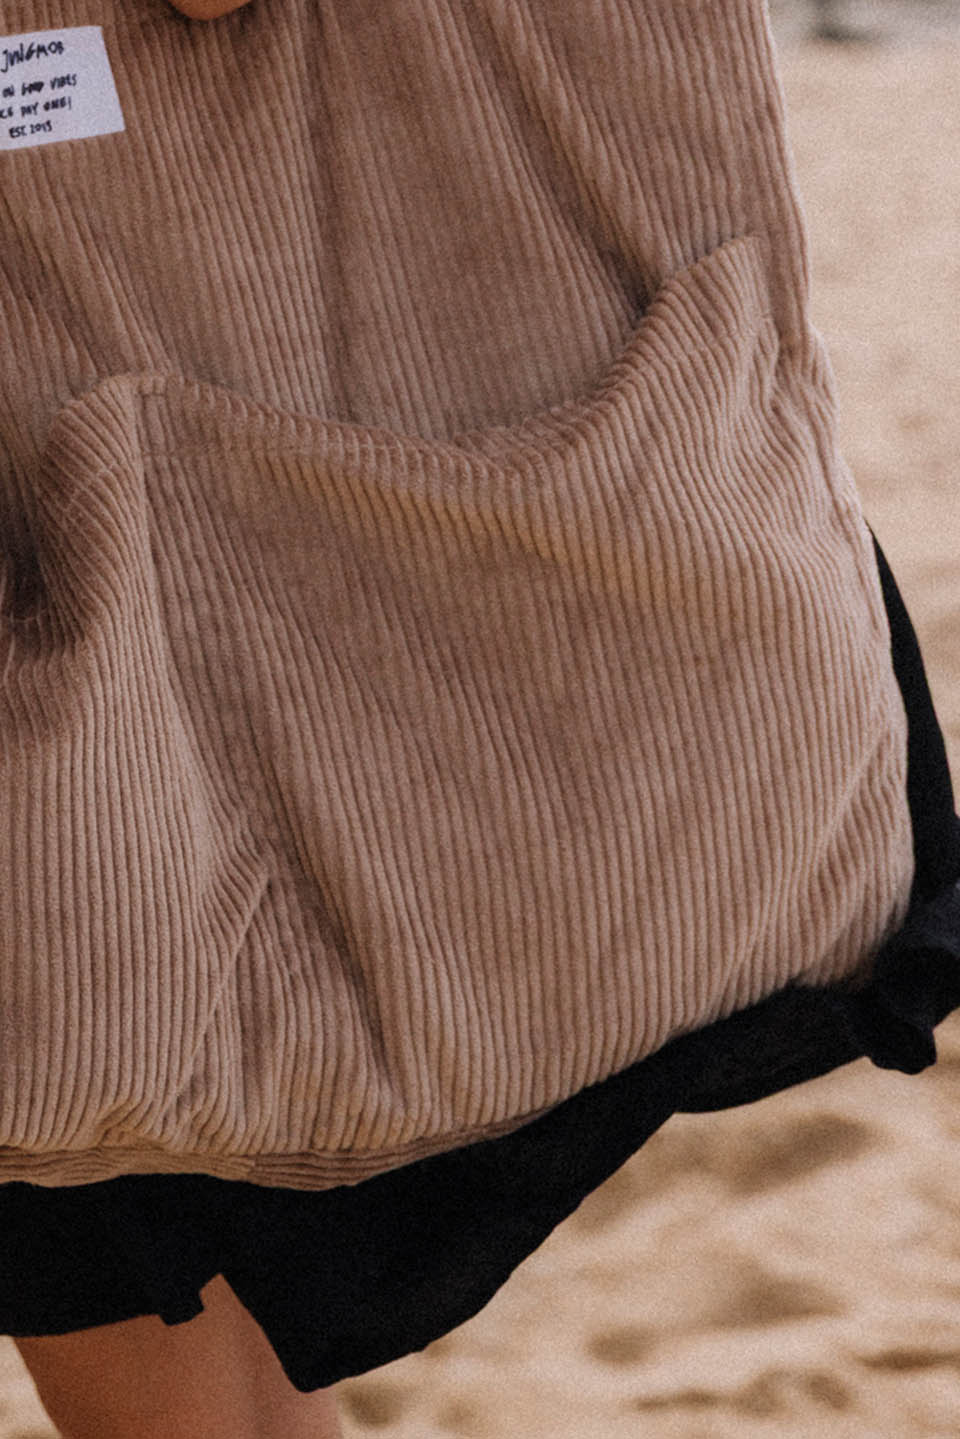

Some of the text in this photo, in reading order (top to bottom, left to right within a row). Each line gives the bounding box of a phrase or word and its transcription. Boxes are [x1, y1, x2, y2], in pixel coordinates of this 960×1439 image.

[2, 85, 15, 99] ON
[50, 73, 77, 90] VIBES
[20, 102, 39, 117] DAY
